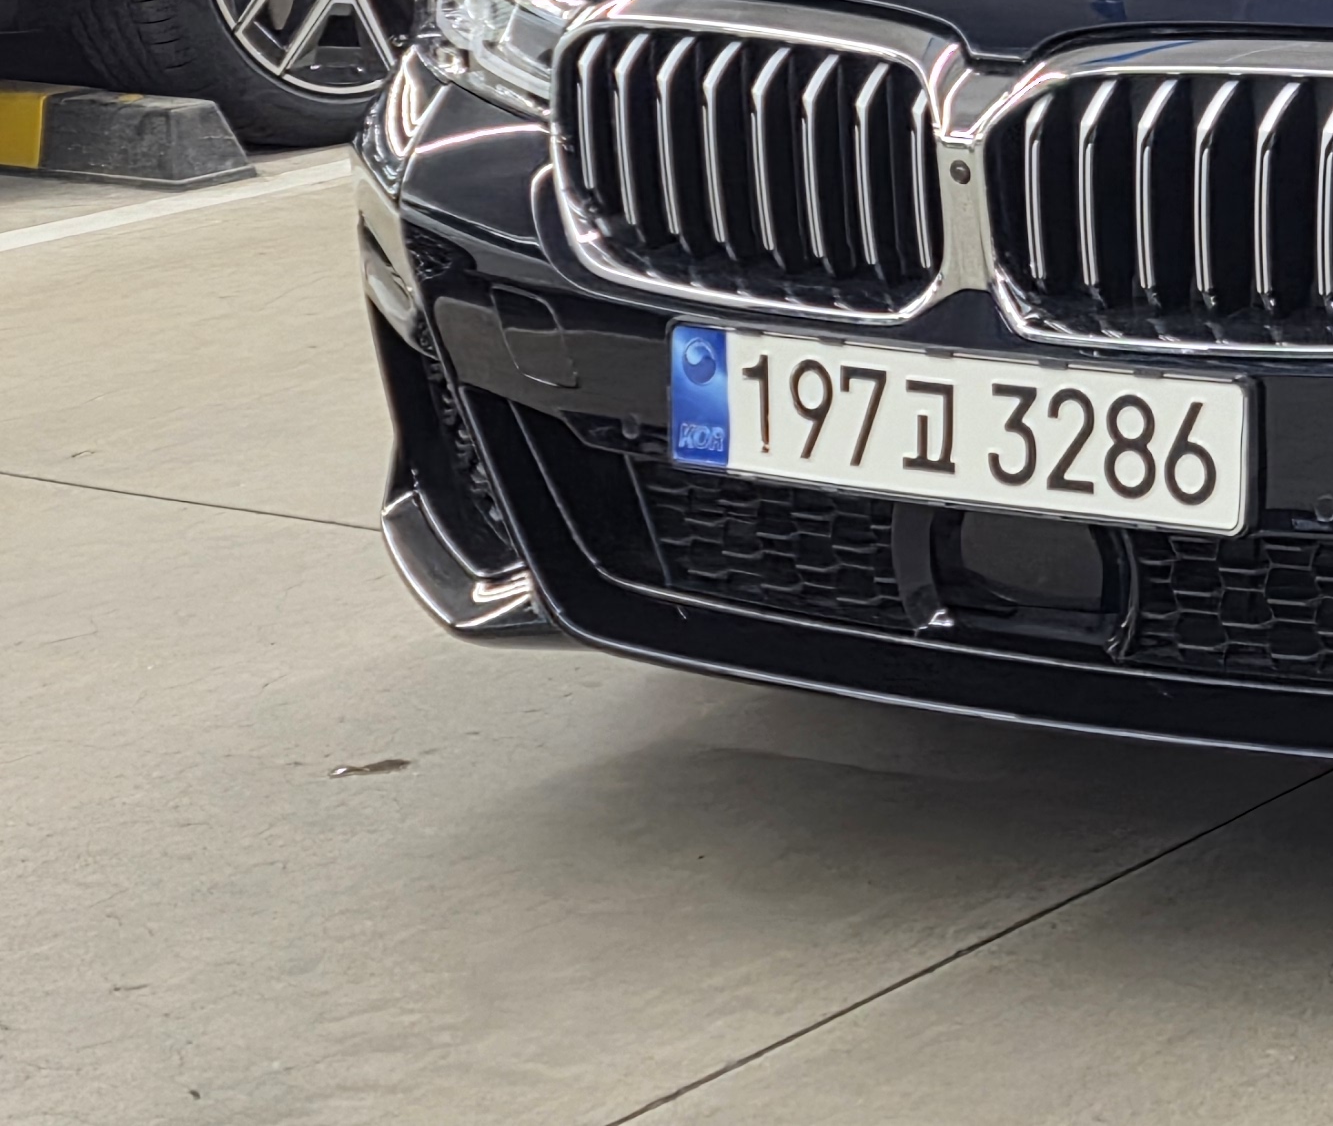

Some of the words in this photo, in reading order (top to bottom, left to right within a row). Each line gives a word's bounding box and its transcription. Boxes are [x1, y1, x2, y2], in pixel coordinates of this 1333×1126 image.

[678, 422, 725, 452] KOR
[741, 354, 957, 475] 197고
[987, 382, 1218, 506] 3286
